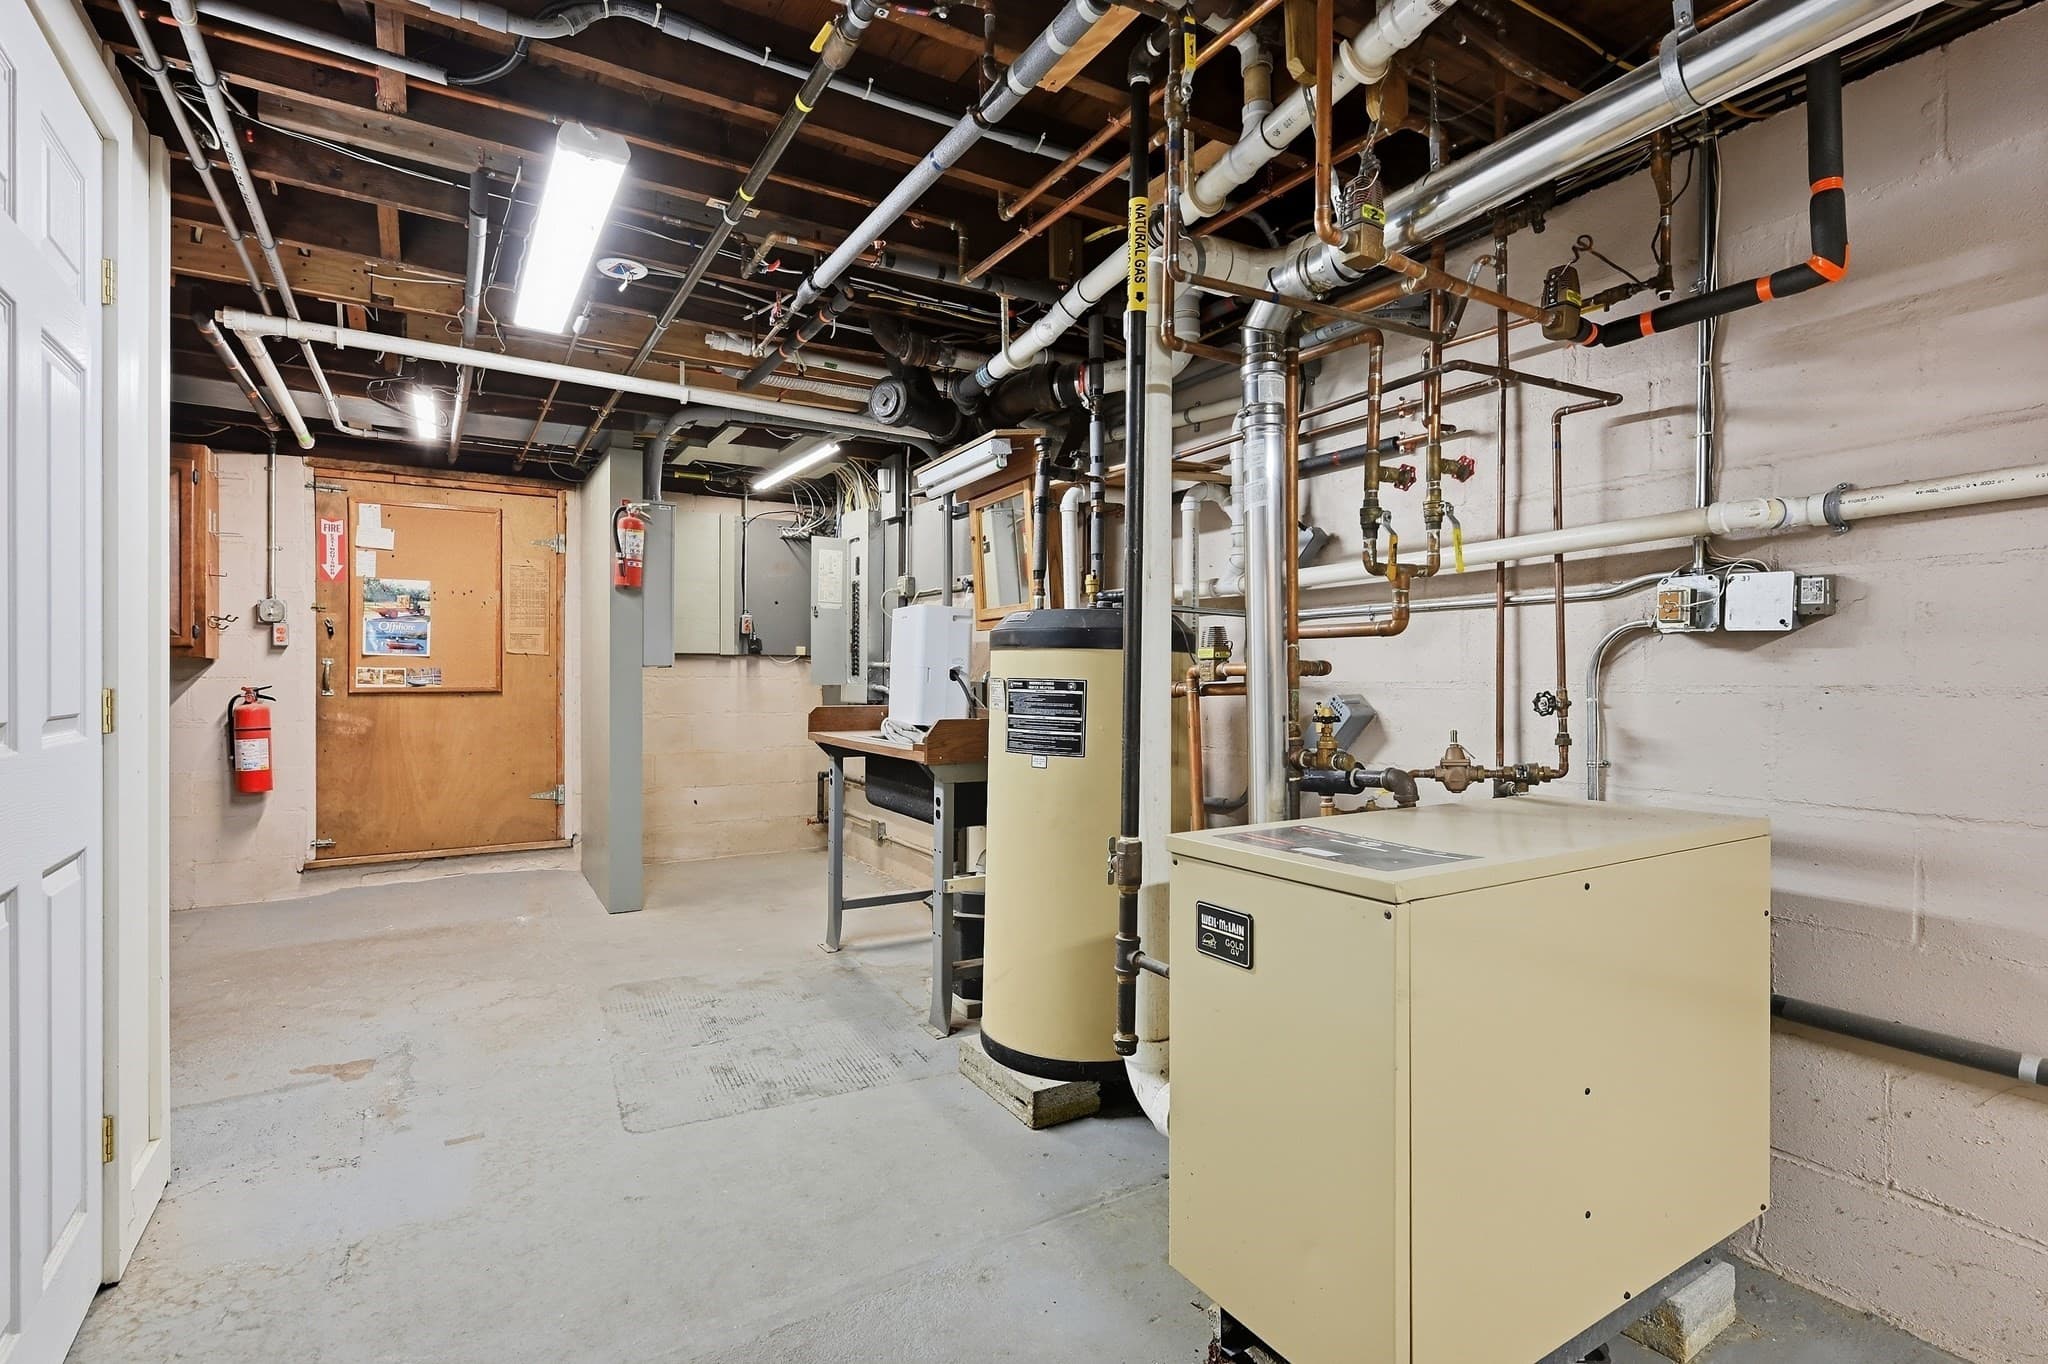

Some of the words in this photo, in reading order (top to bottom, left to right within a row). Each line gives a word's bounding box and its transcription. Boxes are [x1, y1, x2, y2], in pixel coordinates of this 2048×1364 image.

[1134, 203, 1146, 256] NATURAL
[1134, 259, 1146, 284] GAS
[323, 523, 341, 533] FIRE
[1224, 938, 1245, 952] GOLD
